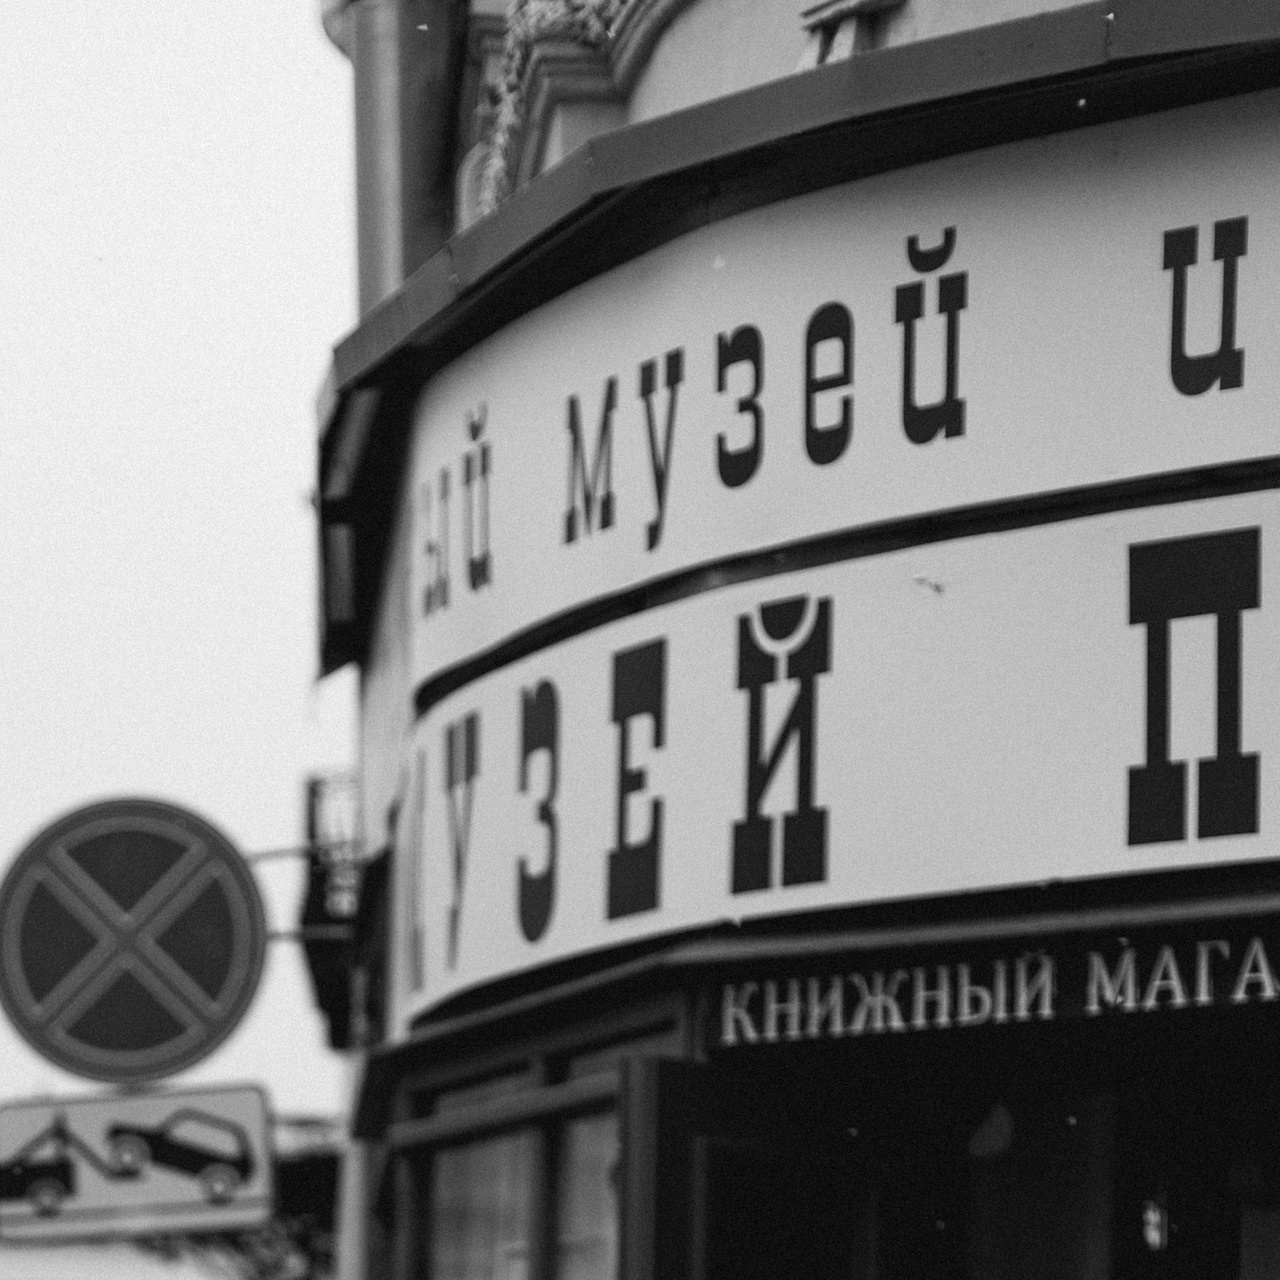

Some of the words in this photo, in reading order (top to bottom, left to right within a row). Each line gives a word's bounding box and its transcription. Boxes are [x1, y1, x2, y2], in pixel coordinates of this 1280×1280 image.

[563, 226, 969, 552] музей
[408, 594, 834, 992] УЗЕЙ
[1128, 524, 1261, 846] П
[721, 949, 1056, 1047] КНИЖНЫЙ
[1084, 936, 1280, 1017] МАГА
